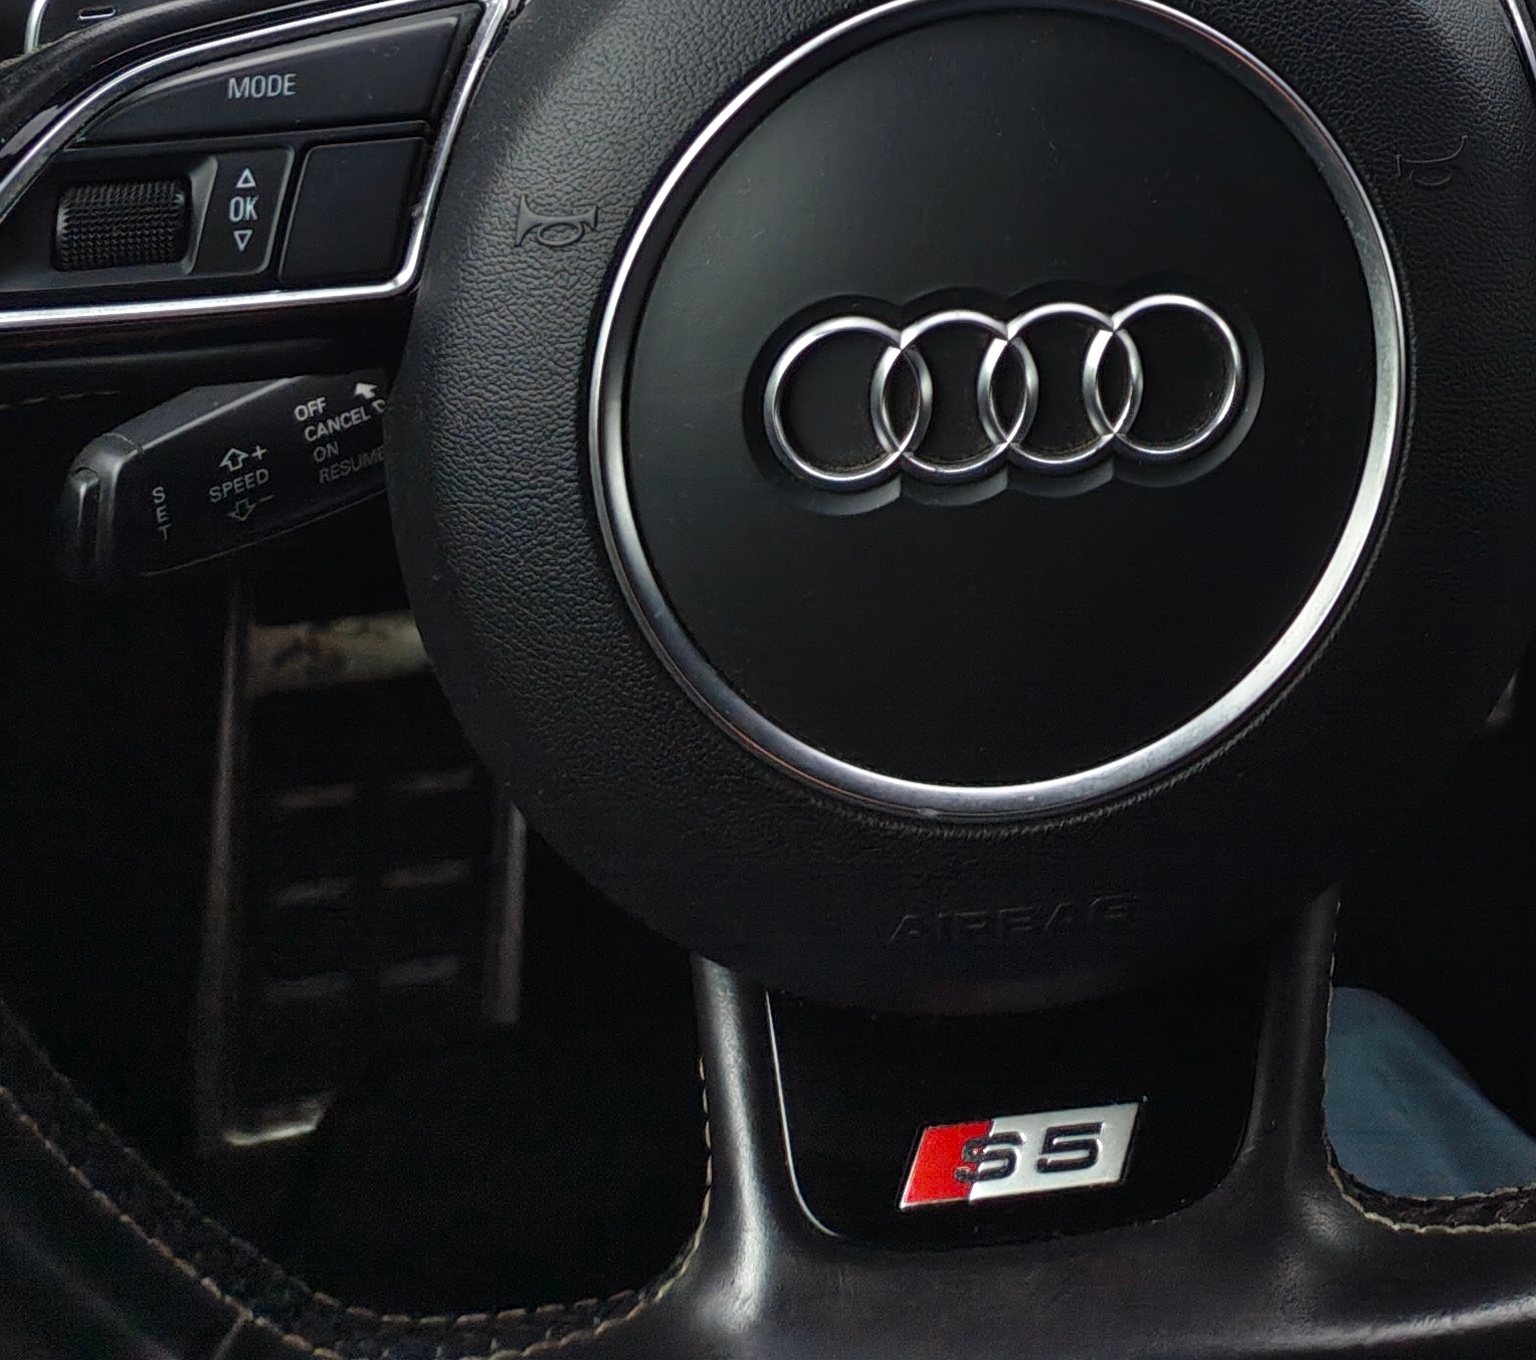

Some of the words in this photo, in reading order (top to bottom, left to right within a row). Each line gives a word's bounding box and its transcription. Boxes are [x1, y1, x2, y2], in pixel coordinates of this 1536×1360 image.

[227, 73, 297, 100] MODE
[228, 195, 259, 222] OK
[294, 396, 327, 422] OFF
[304, 408, 372, 442] CANCEL
[312, 441, 340, 463] ON
[208, 468, 270, 504] SPEED
[955, 1120, 1105, 1182] S5
